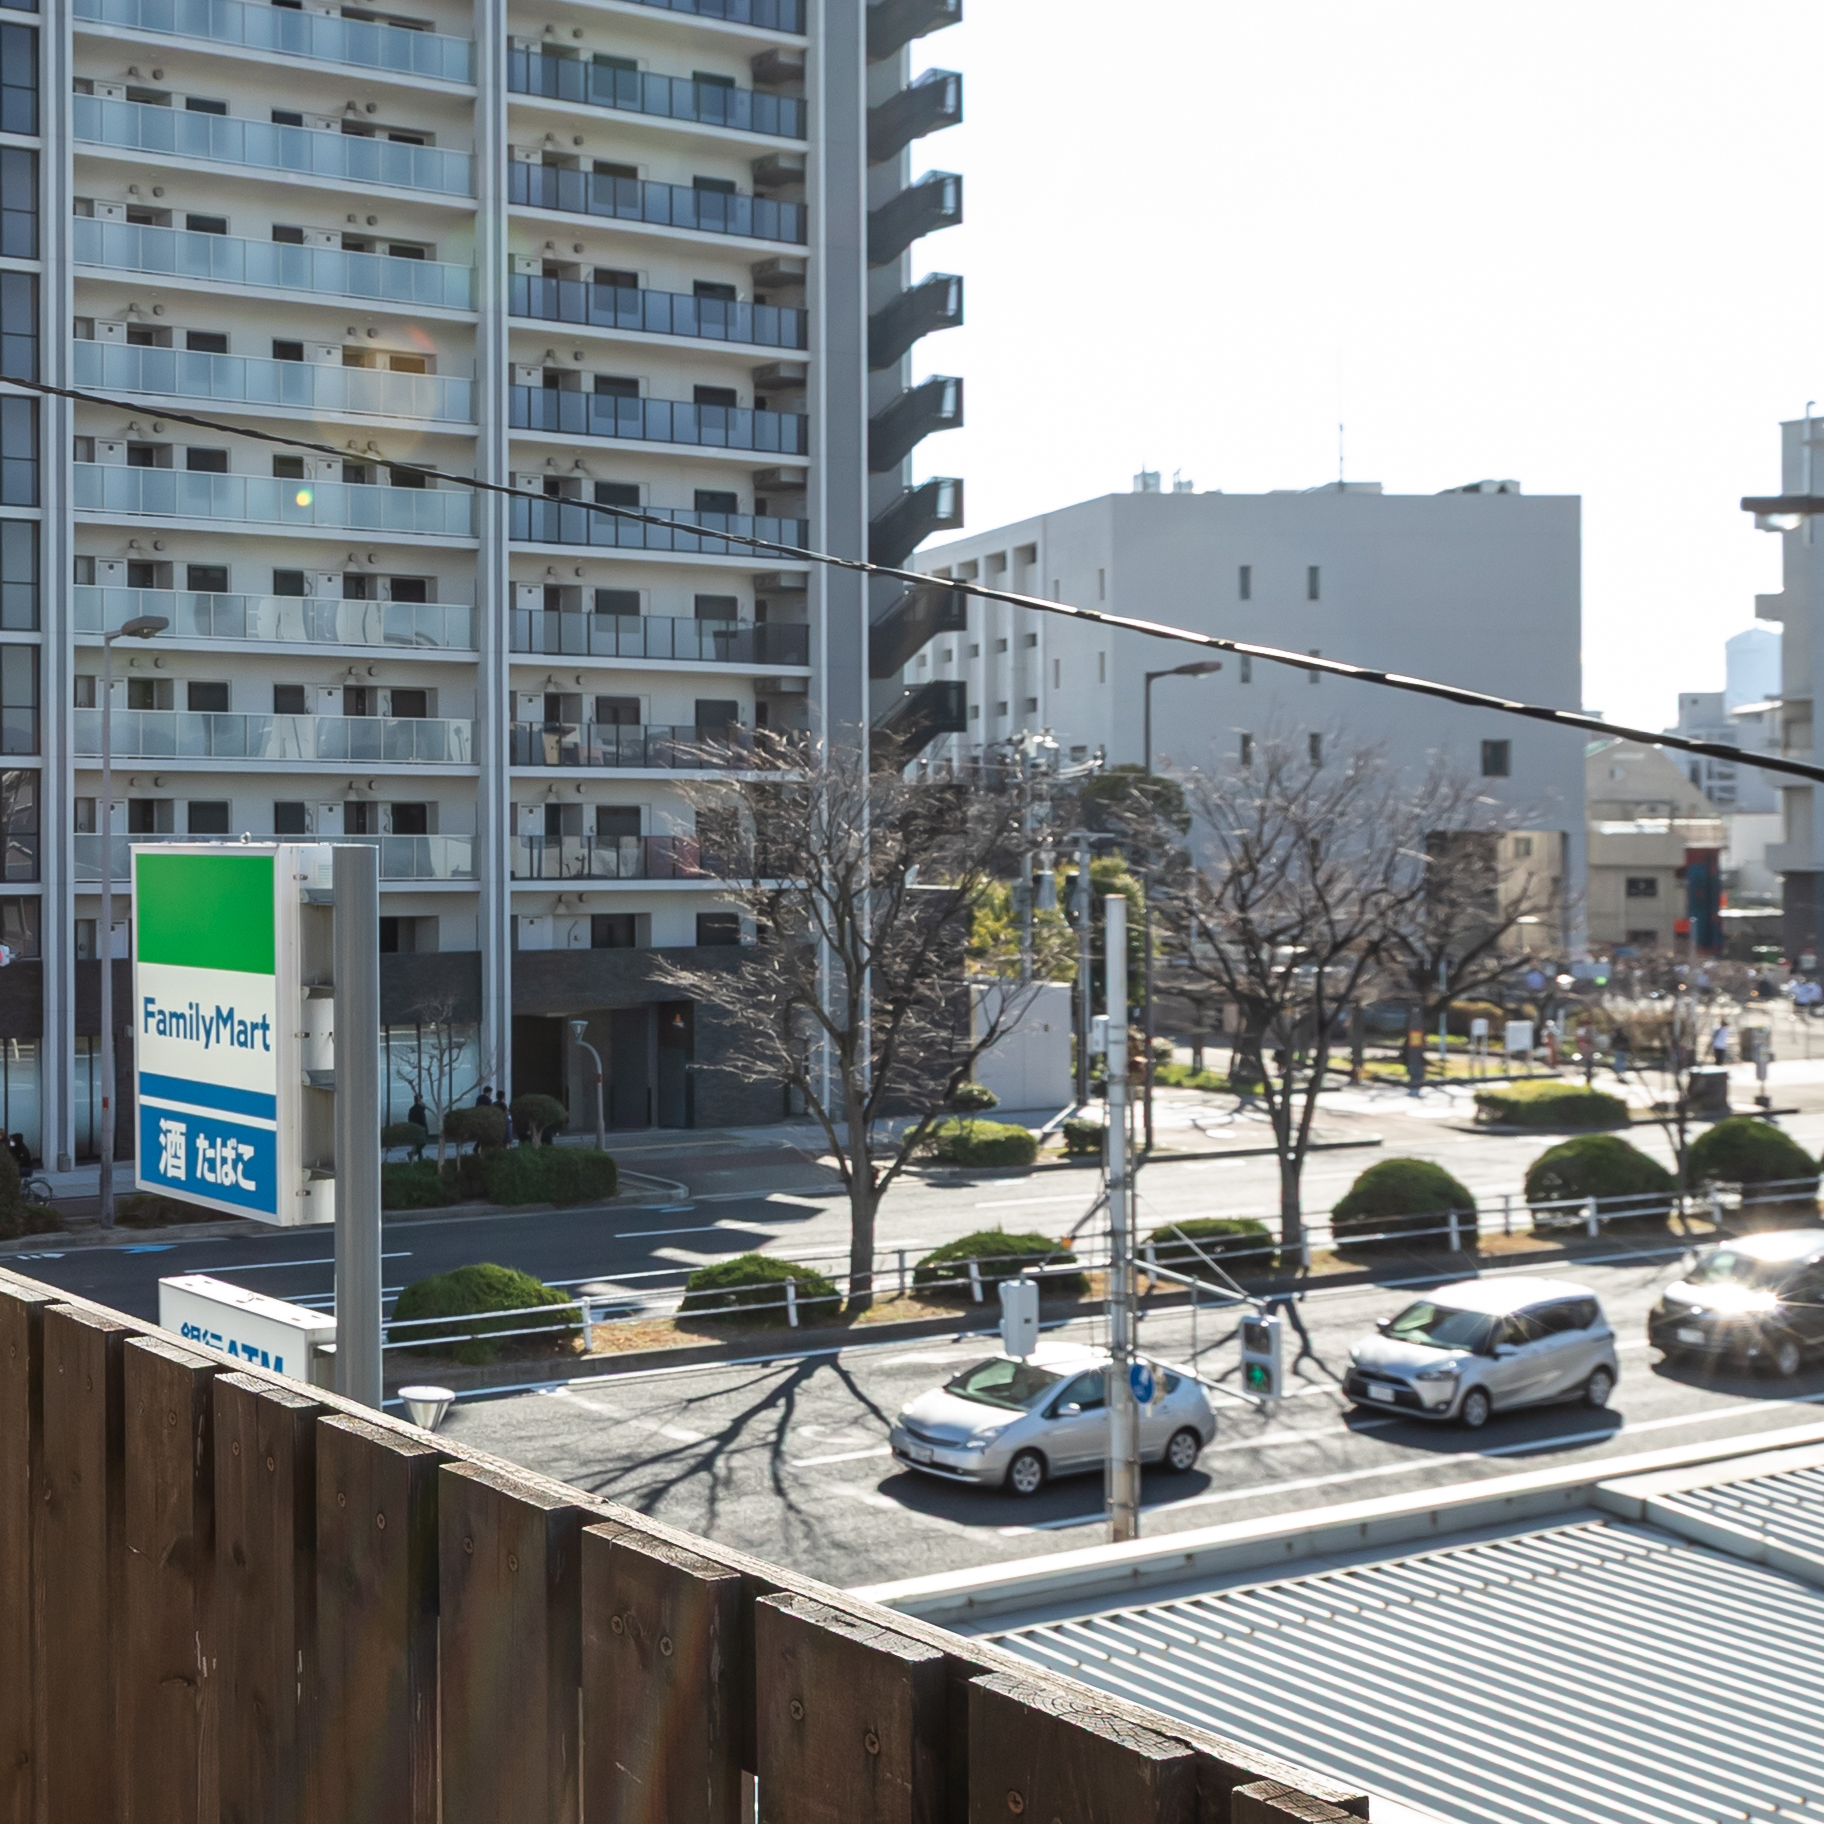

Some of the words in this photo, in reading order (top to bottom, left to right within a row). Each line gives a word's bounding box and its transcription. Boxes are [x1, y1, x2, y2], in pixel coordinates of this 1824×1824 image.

[143, 996, 270, 1052] FamilyMart
[159, 1117, 186, 1181] 酒
[196, 1133, 256, 1191] たばこ
